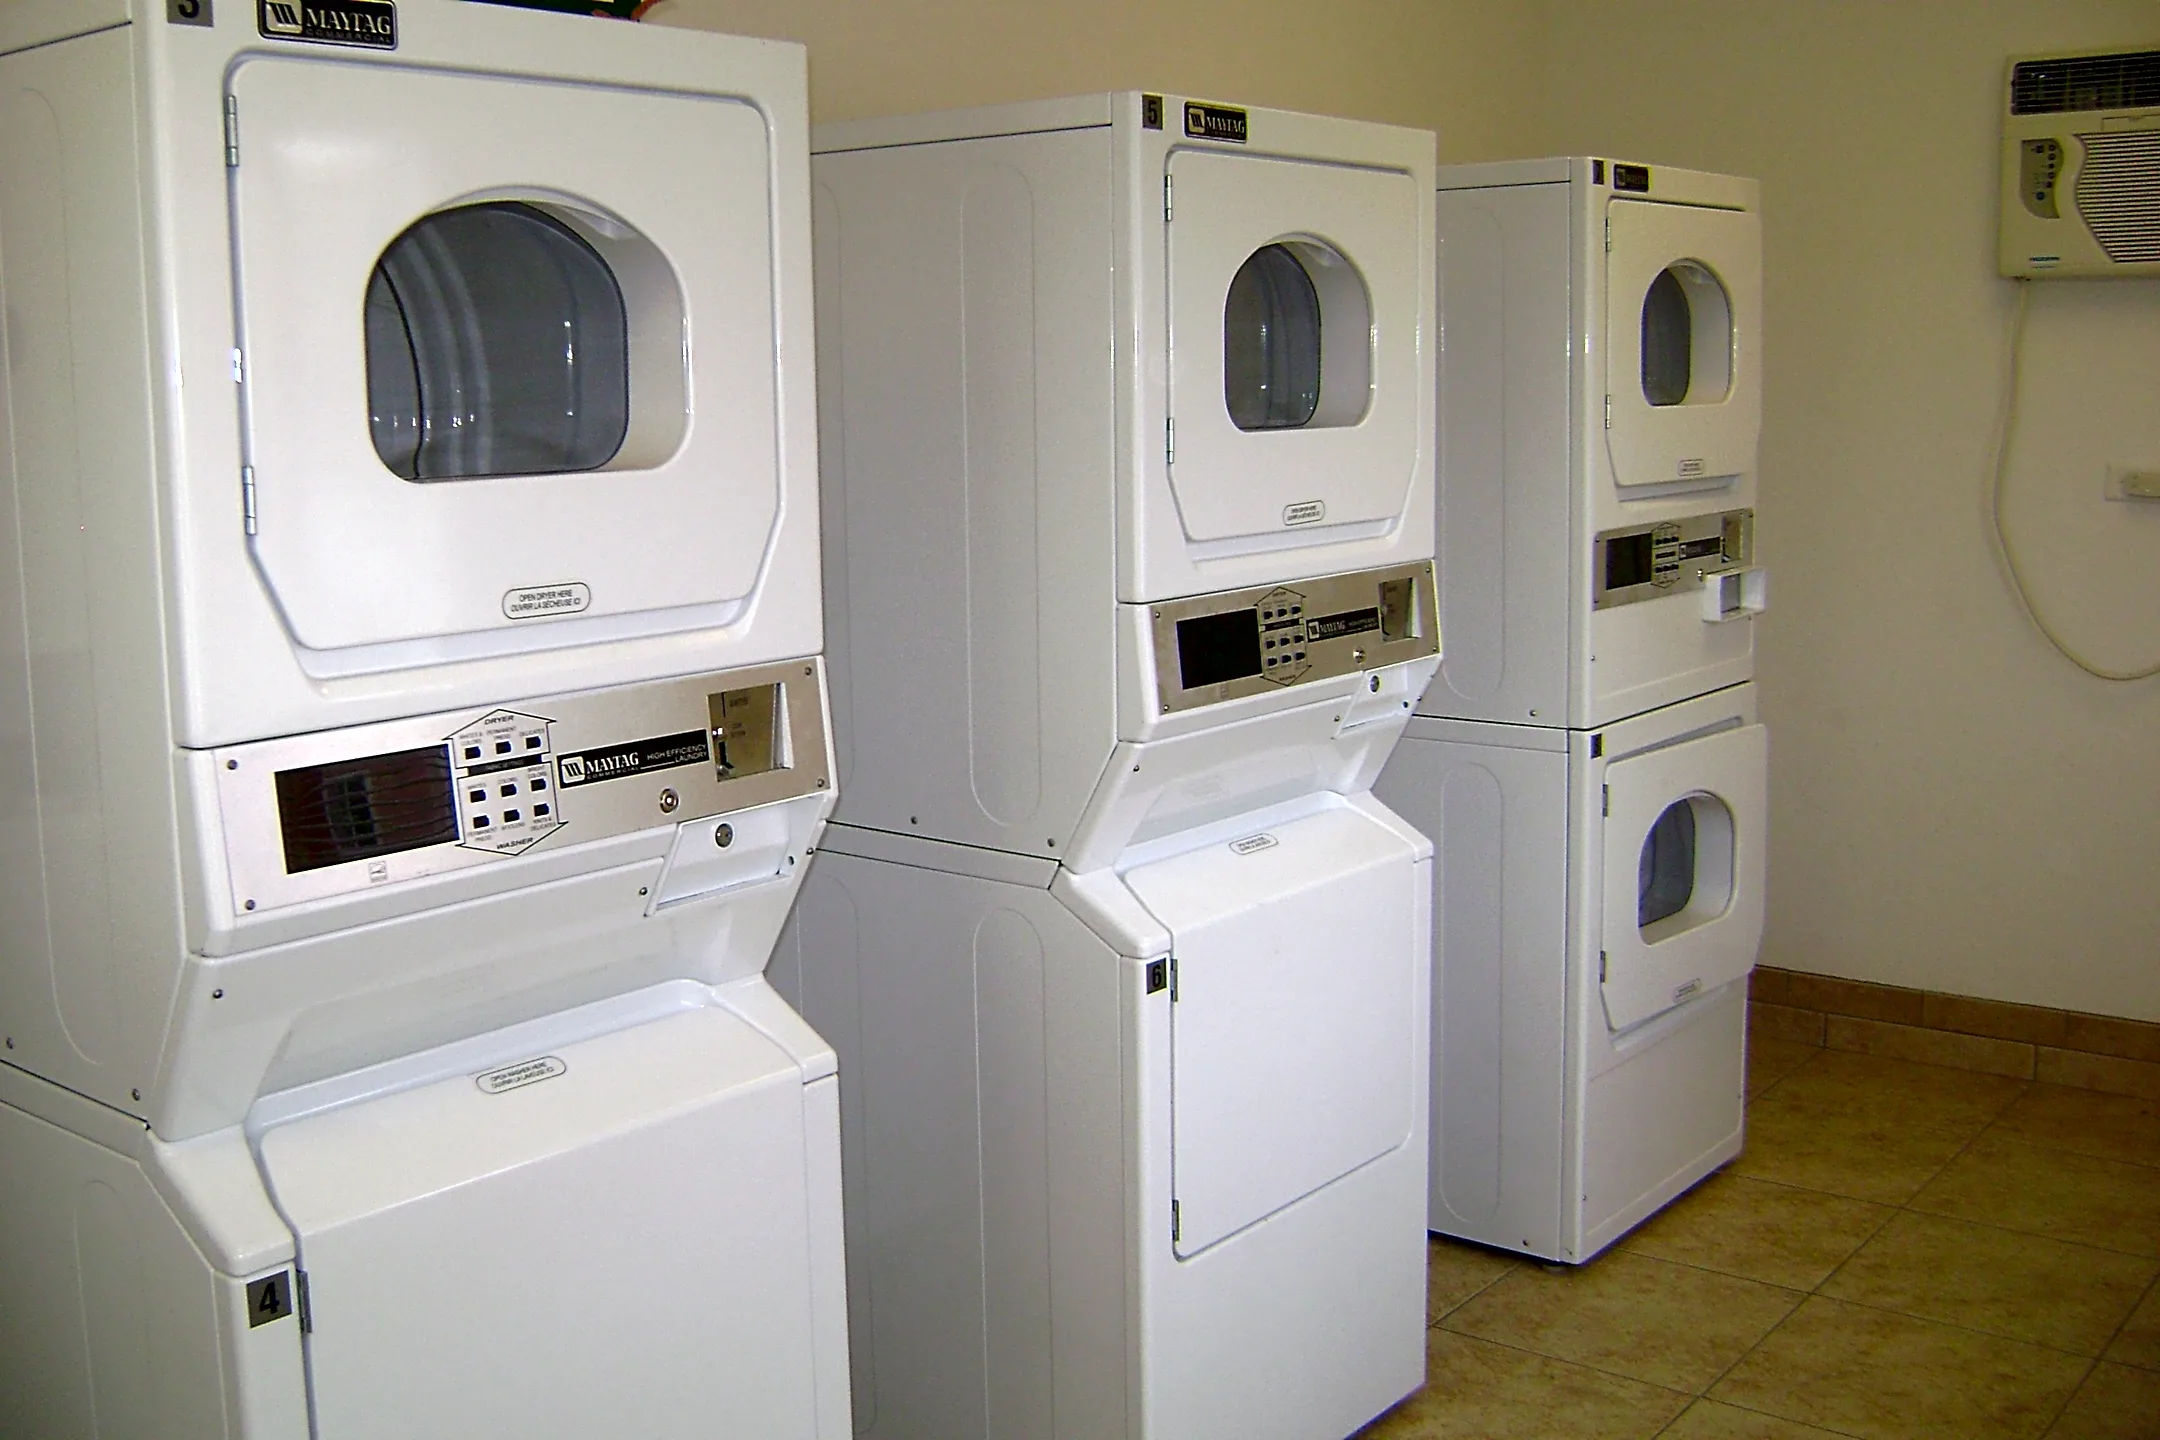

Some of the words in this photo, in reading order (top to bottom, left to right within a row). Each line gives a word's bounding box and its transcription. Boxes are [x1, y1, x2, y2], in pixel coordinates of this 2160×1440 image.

[306, 8, 391, 35] MAYTAG
[1148, 100, 1158, 124] 5
[1206, 116, 1245, 133] MAYTAG
[484, 715, 514, 725] DRYER
[647, 752, 666, 761] HIGH
[666, 744, 706, 758] EFFICIENCY
[675, 751, 707, 763] LAUNDRY
[586, 752, 639, 774] MAYTAG
[497, 837, 533, 849] WASHER
[1152, 964, 1161, 987] 6
[259, 1281, 280, 1314] 4
